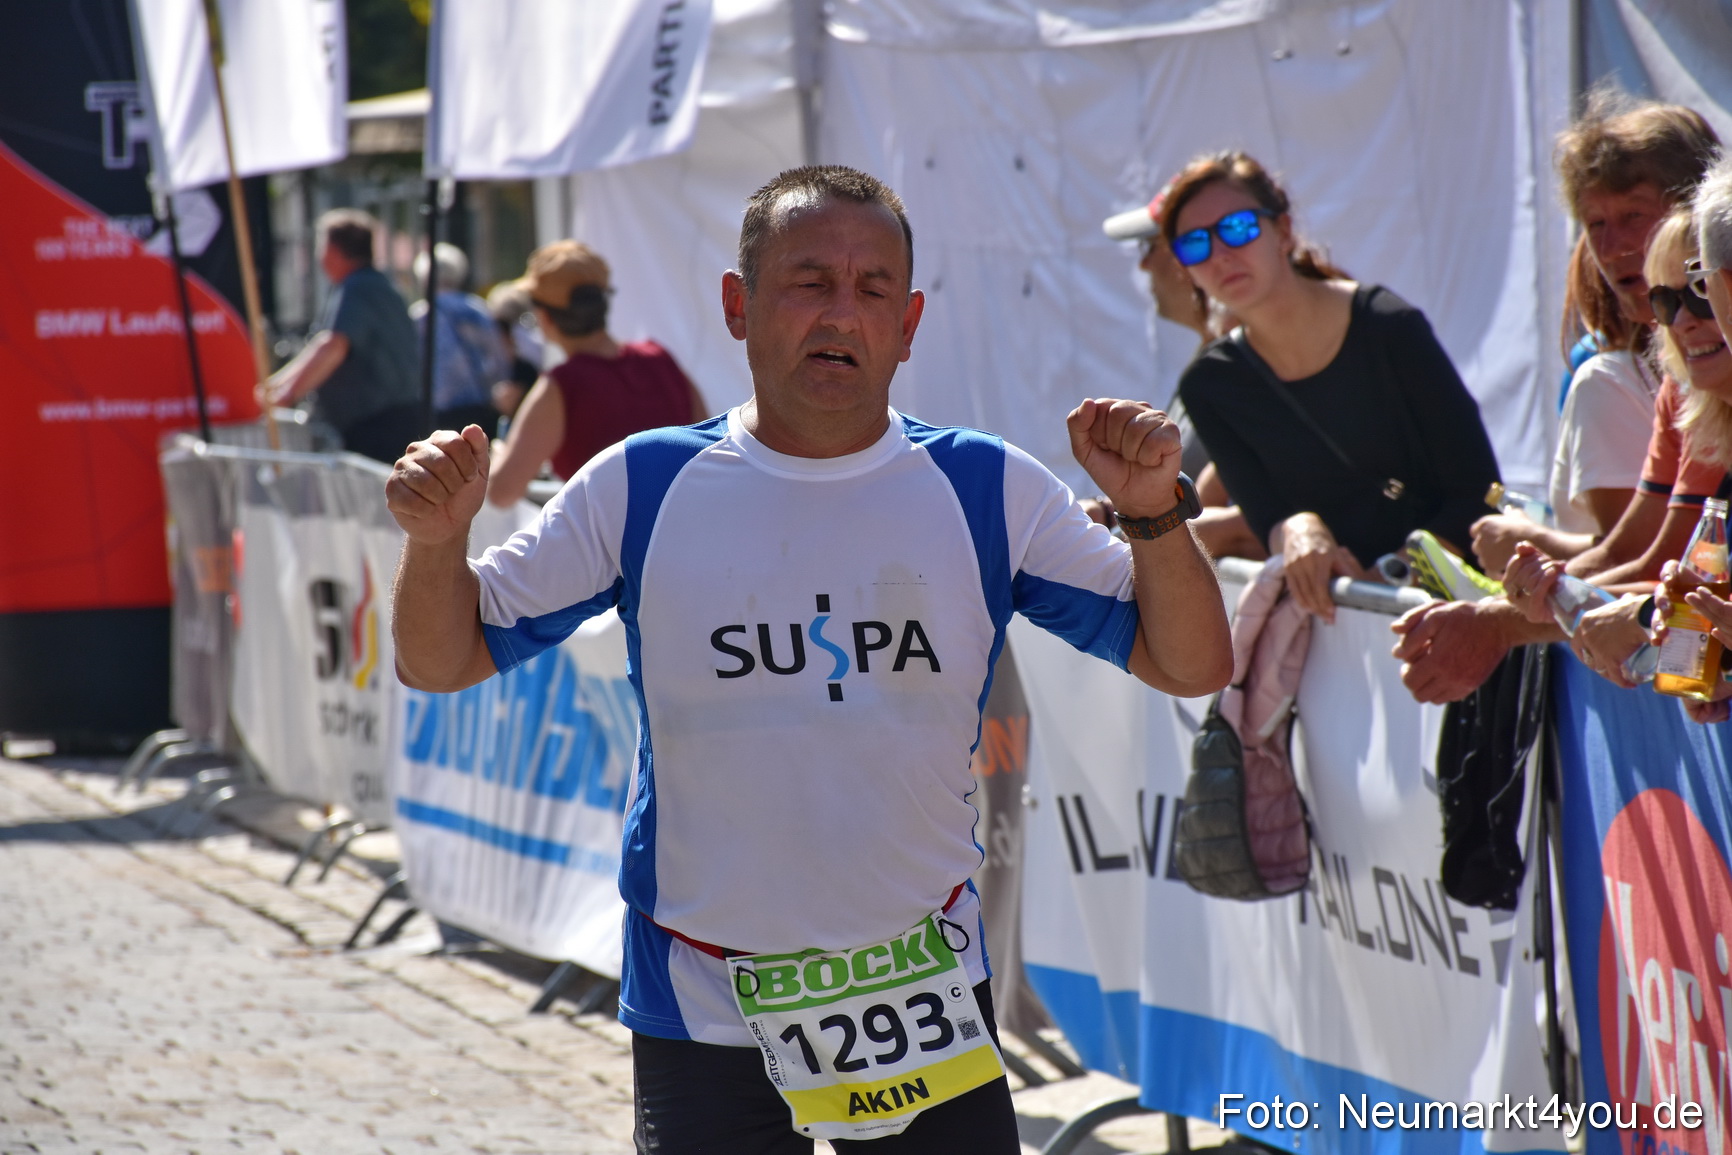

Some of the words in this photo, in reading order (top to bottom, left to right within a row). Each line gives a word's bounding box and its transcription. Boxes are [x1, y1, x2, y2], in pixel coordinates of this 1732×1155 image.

[35, 309, 105, 339] BMW
[710, 593, 941, 702] SUSPA
[779, 992, 955, 1075] 1293
[849, 1077, 931, 1116] AKIN
